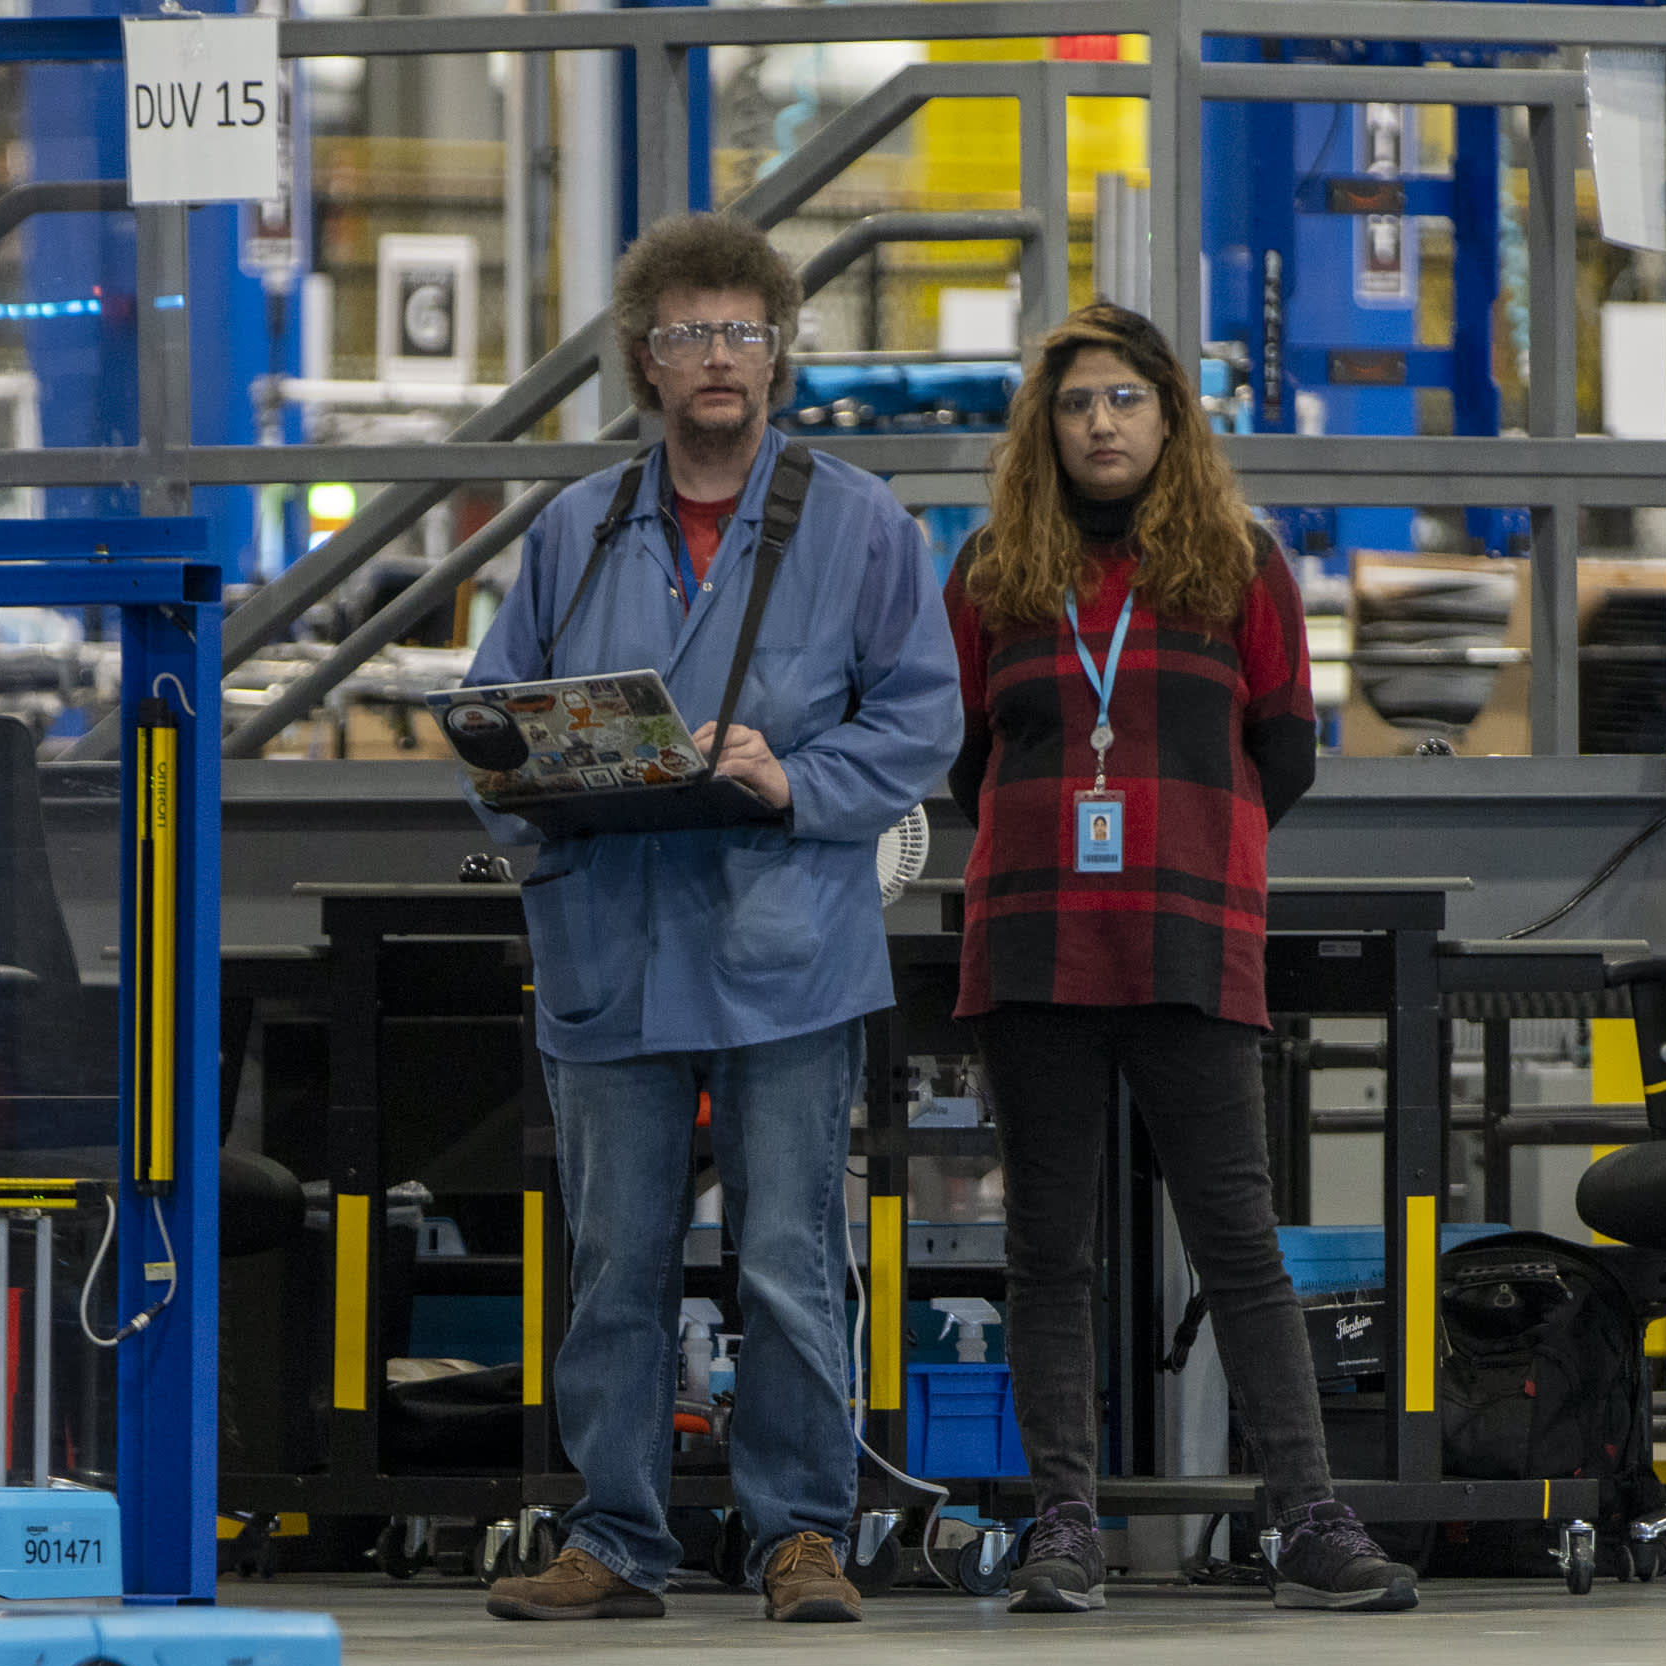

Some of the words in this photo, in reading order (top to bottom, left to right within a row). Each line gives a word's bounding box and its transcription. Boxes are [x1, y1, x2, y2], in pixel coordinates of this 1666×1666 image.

[135, 81, 202, 130] DUV
[215, 80, 265, 128] 15
[1336, 1314, 1373, 1340] Florsheim
[24, 1538, 102, 1565] 901471
